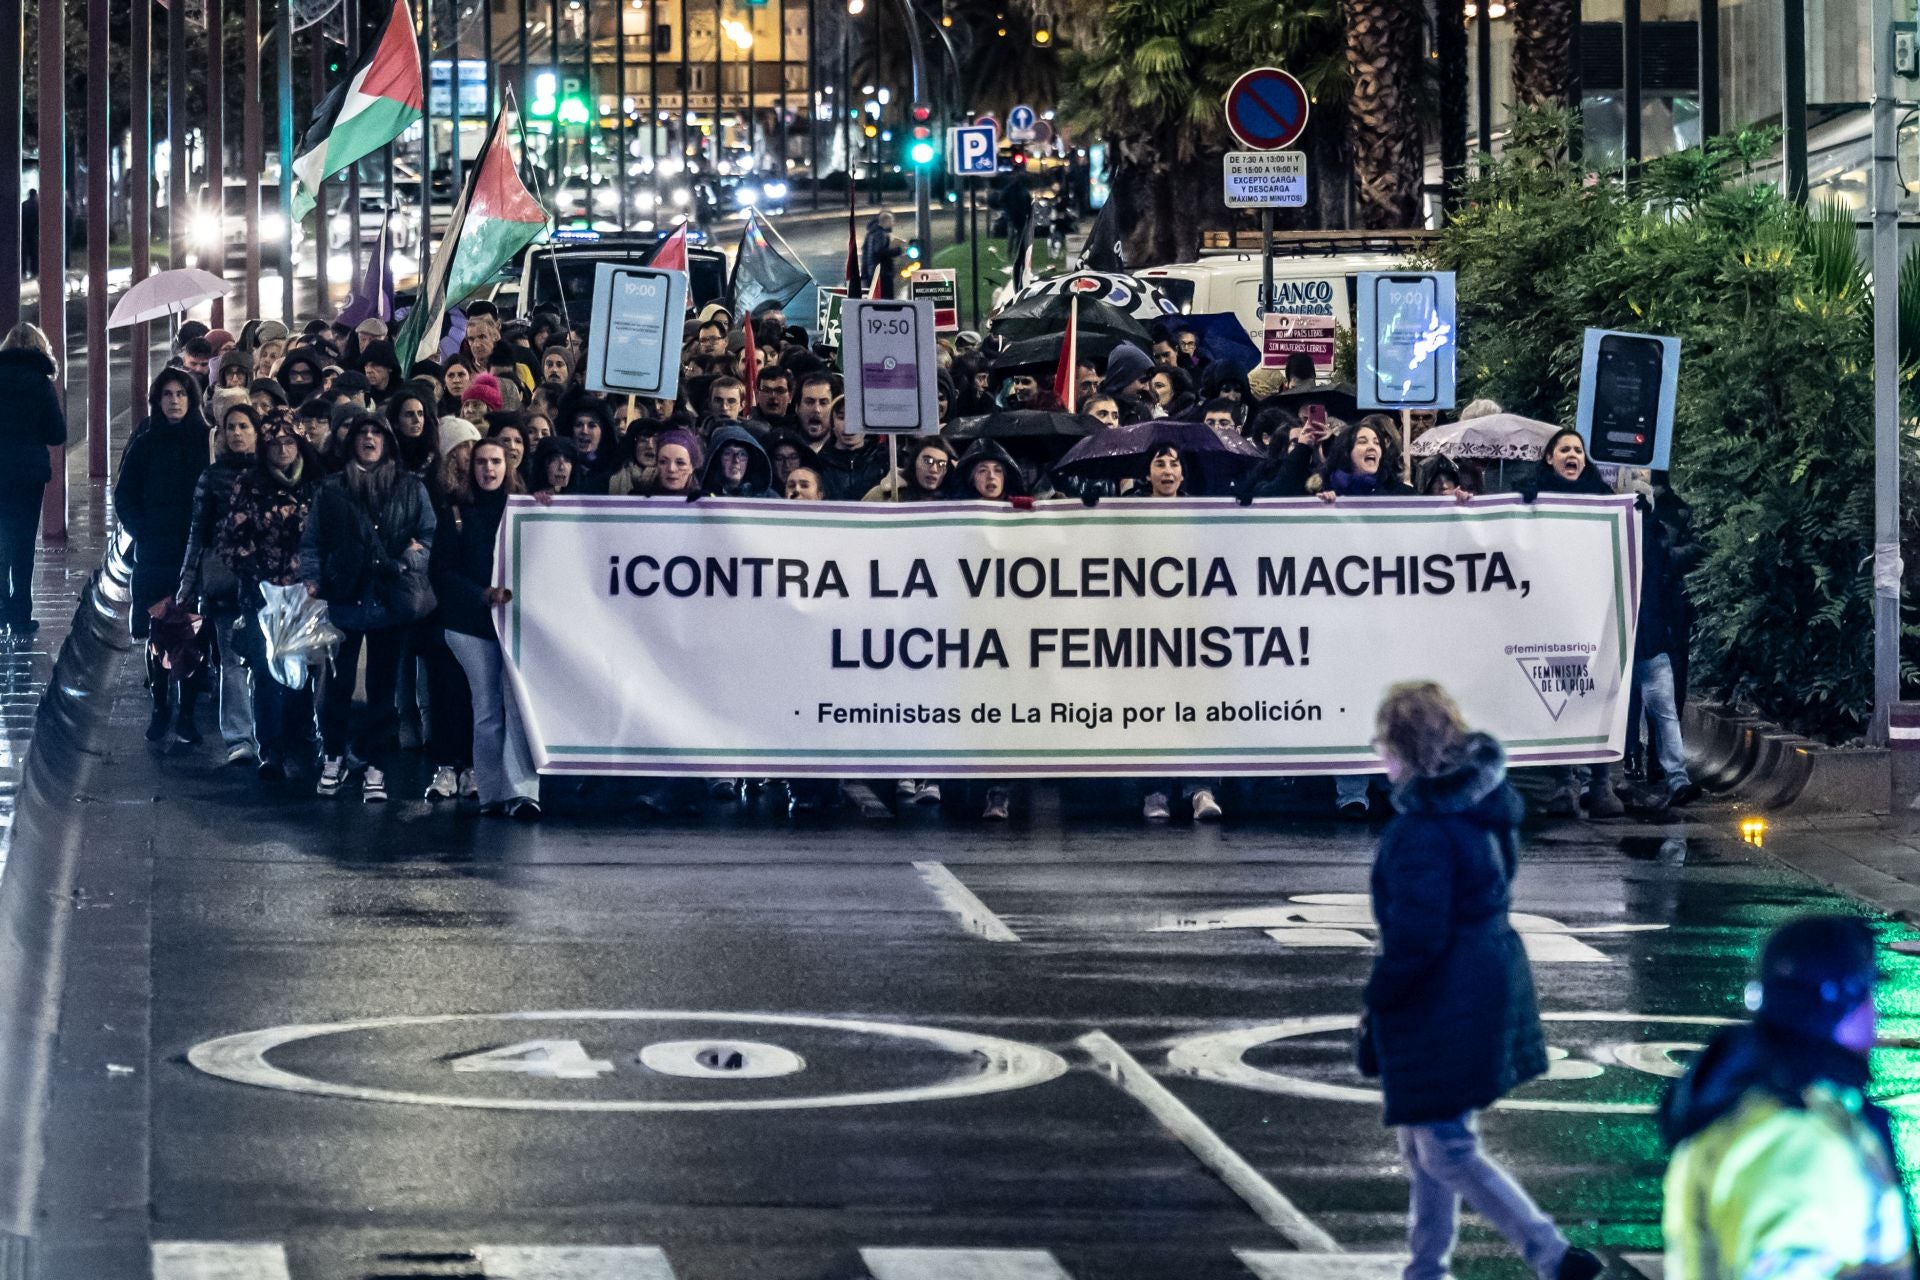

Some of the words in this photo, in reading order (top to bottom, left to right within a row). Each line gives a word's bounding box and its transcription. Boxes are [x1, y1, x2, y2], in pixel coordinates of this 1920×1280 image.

[963, 133, 987, 169] P
[1229, 156, 1240, 164] DE
[1266, 155, 1285, 163] 13:00
[1231, 166, 1242, 174] DE
[1244, 166, 1263, 174] 15:00
[1293, 165, 1299, 173] H
[1233, 176, 1268, 184] EXCEPTO
[1270, 176, 1297, 184] CARGA
[1241, 185, 1246, 193] Y
[1248, 185, 1290, 193] DESCARGA
[1269, 194, 1303, 203] MINUTOS)
[625, 283, 656, 297] 19:00
[867, 319, 909, 335] 19:50
[1279, 343, 1306, 352] MUJERES
[1306, 344, 1327, 353] LIBRES
[609, 555, 850, 598] ¡CONTRA
[870, 558, 938, 598] LA
[958, 556, 1238, 598] VIOLENCIA
[1258, 551, 1531, 598] MACHISTA,
[831, 627, 1010, 670] LUCHA
[1030, 625, 1310, 668] FEMINISTA!
[1504, 642, 1597, 656] @feministasrioja
[1533, 664, 1589, 679] FEMINISTAS
[1541, 679, 1553, 693] DE
[1555, 679, 1567, 692] LA
[1569, 677, 1595, 694] RIOJA
[818, 702, 961, 724] Feministas
[970, 702, 1002, 724] de
[1011, 702, 1041, 724] La
[1050, 702, 1113, 730] Rioja
[1123, 706, 1166, 730] por
[1175, 701, 1196, 723] la
[1205, 699, 1322, 722] abolición
[449, 1039, 806, 1079] 40
